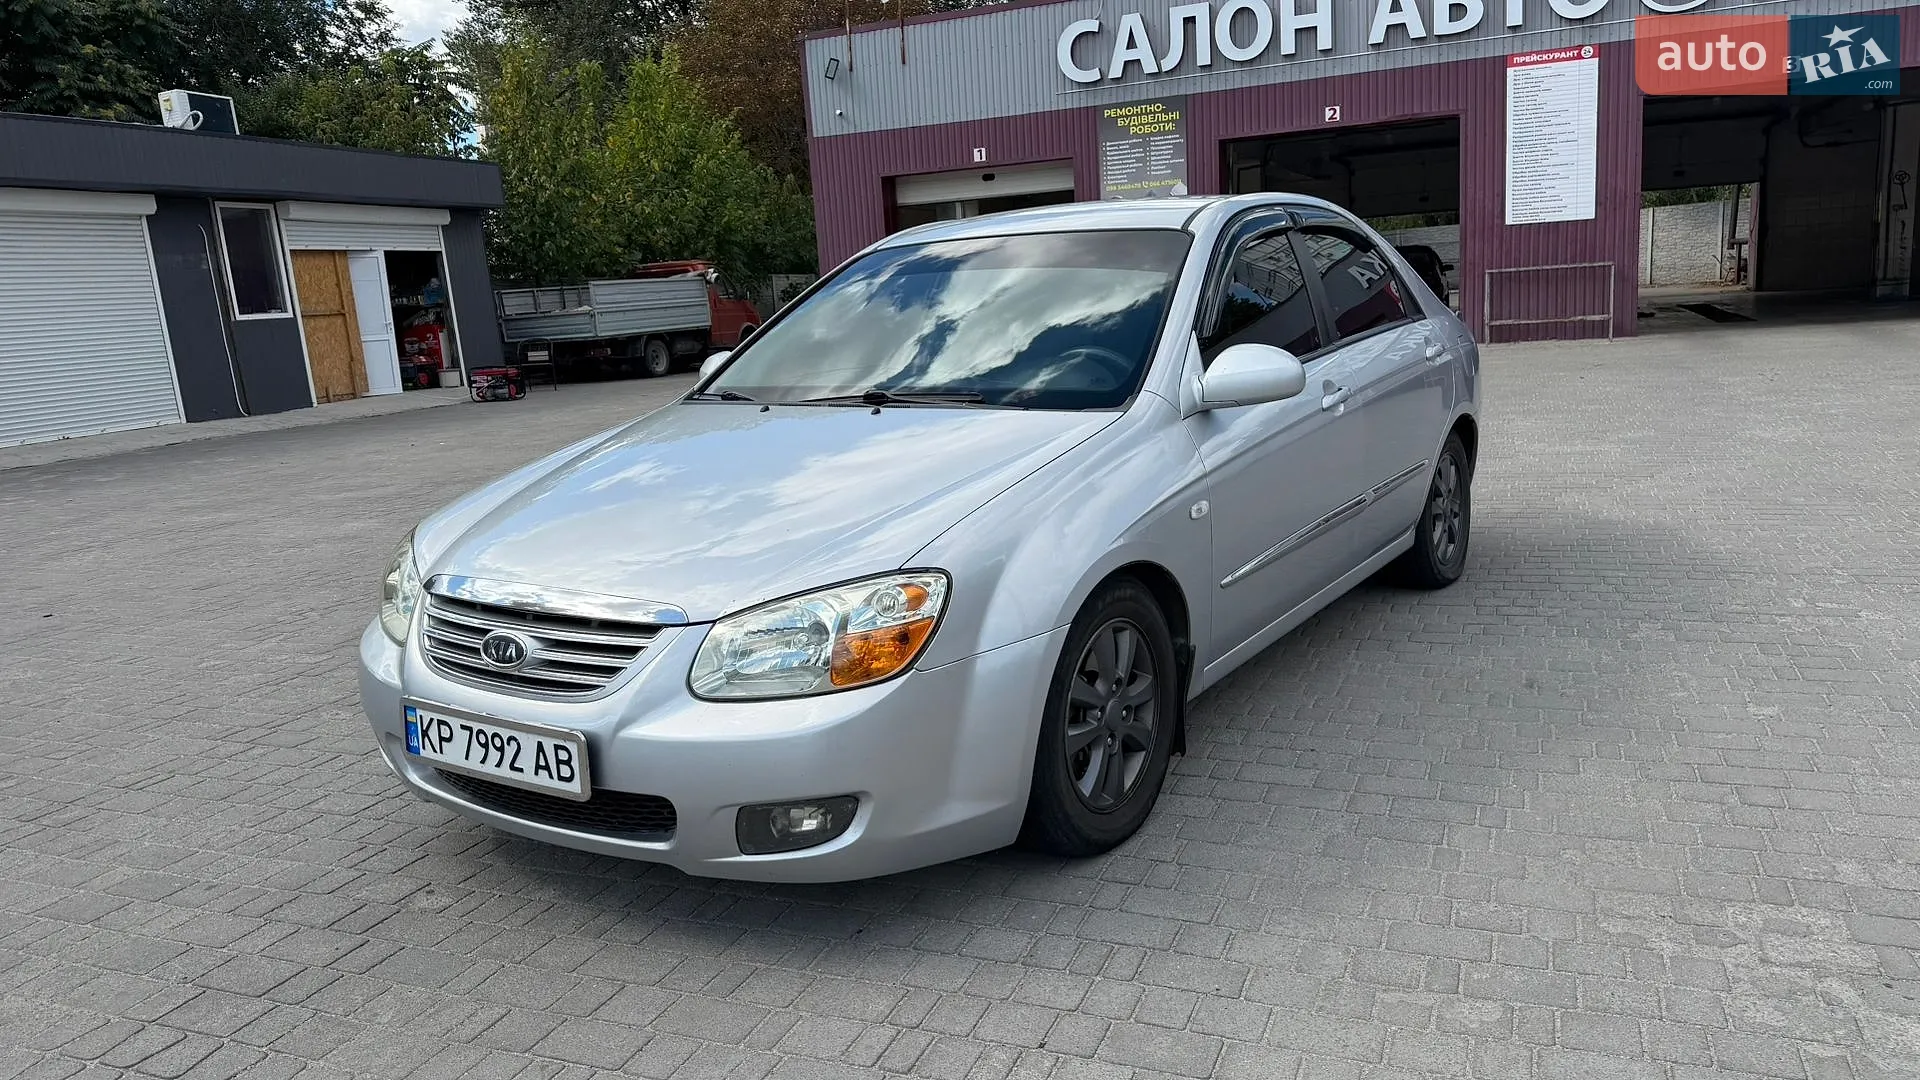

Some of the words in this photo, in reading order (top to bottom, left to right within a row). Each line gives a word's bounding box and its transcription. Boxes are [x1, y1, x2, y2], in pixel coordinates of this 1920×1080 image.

[1056, 0, 1333, 83] САЛОН
[1513, 50, 1579, 64] ПРЕЙСКУРАНТ
[1104, 103, 1166, 118] РЕМОНТНО-
[1328, 107, 1338, 120] 2
[1117, 111, 1180, 126] БУДІВЕЛЬНІ
[1130, 122, 1176, 135] РОБОТИ:
[977, 149, 983, 160] 1
[488, 640, 517, 662] KIA
[408, 734, 418, 748] UA
[419, 714, 453, 755] KP
[459, 723, 524, 773] 7992
[533, 740, 575, 783] AB
